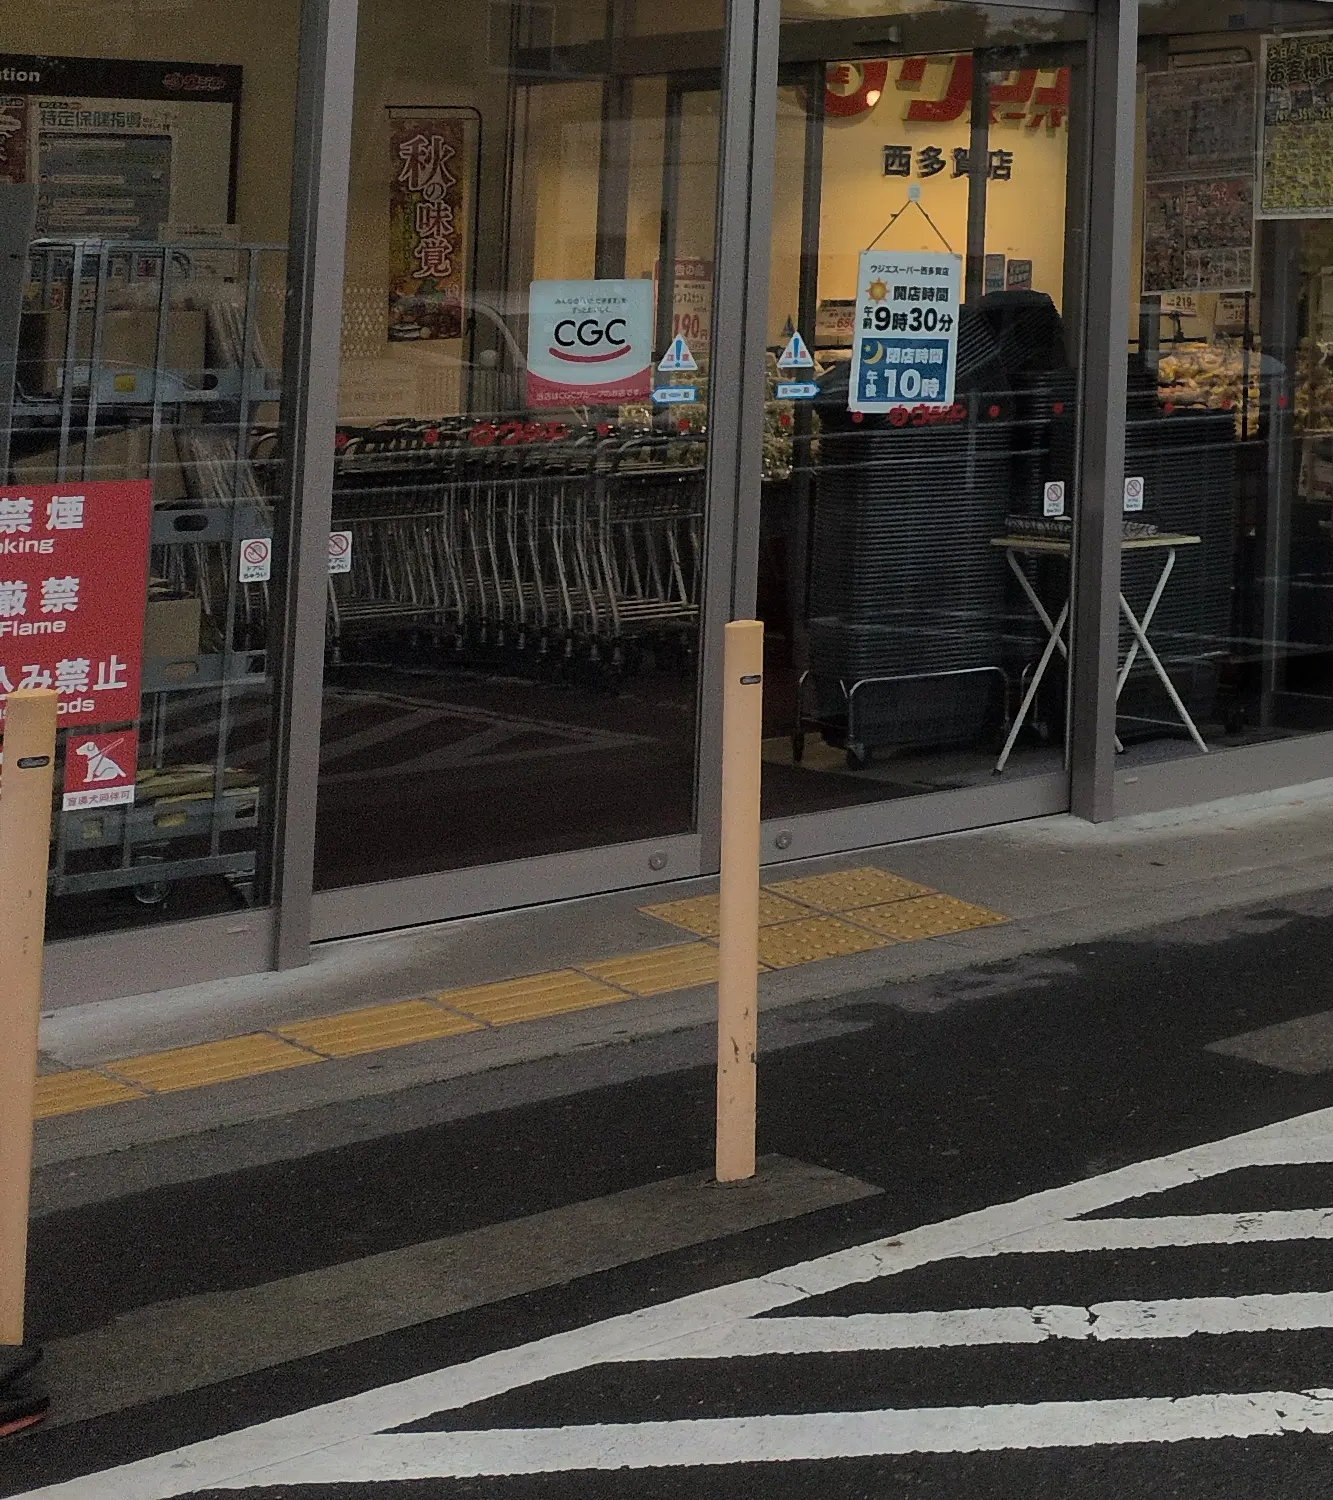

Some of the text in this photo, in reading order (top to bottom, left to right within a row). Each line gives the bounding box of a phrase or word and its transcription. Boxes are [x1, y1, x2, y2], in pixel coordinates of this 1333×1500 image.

[882, 144, 1014, 181] 西多賀店
[398, 134, 456, 278] 秋の味覚
[870, 264, 950, 277] ウジエスーパー西多賀店
[893, 286, 950, 303] 開店時間
[862, 306, 874, 330] 午前
[874, 306, 954, 332] 9時30分
[554, 318, 628, 347] CGC
[886, 347, 944, 365] 閉店時間
[884, 368, 940, 399] 10時
[0, 495, 85, 534] 禁煙
[0, 537, 55, 554] king
[0, 620, 67, 638] Flame
[57, 697, 95, 715] ods
